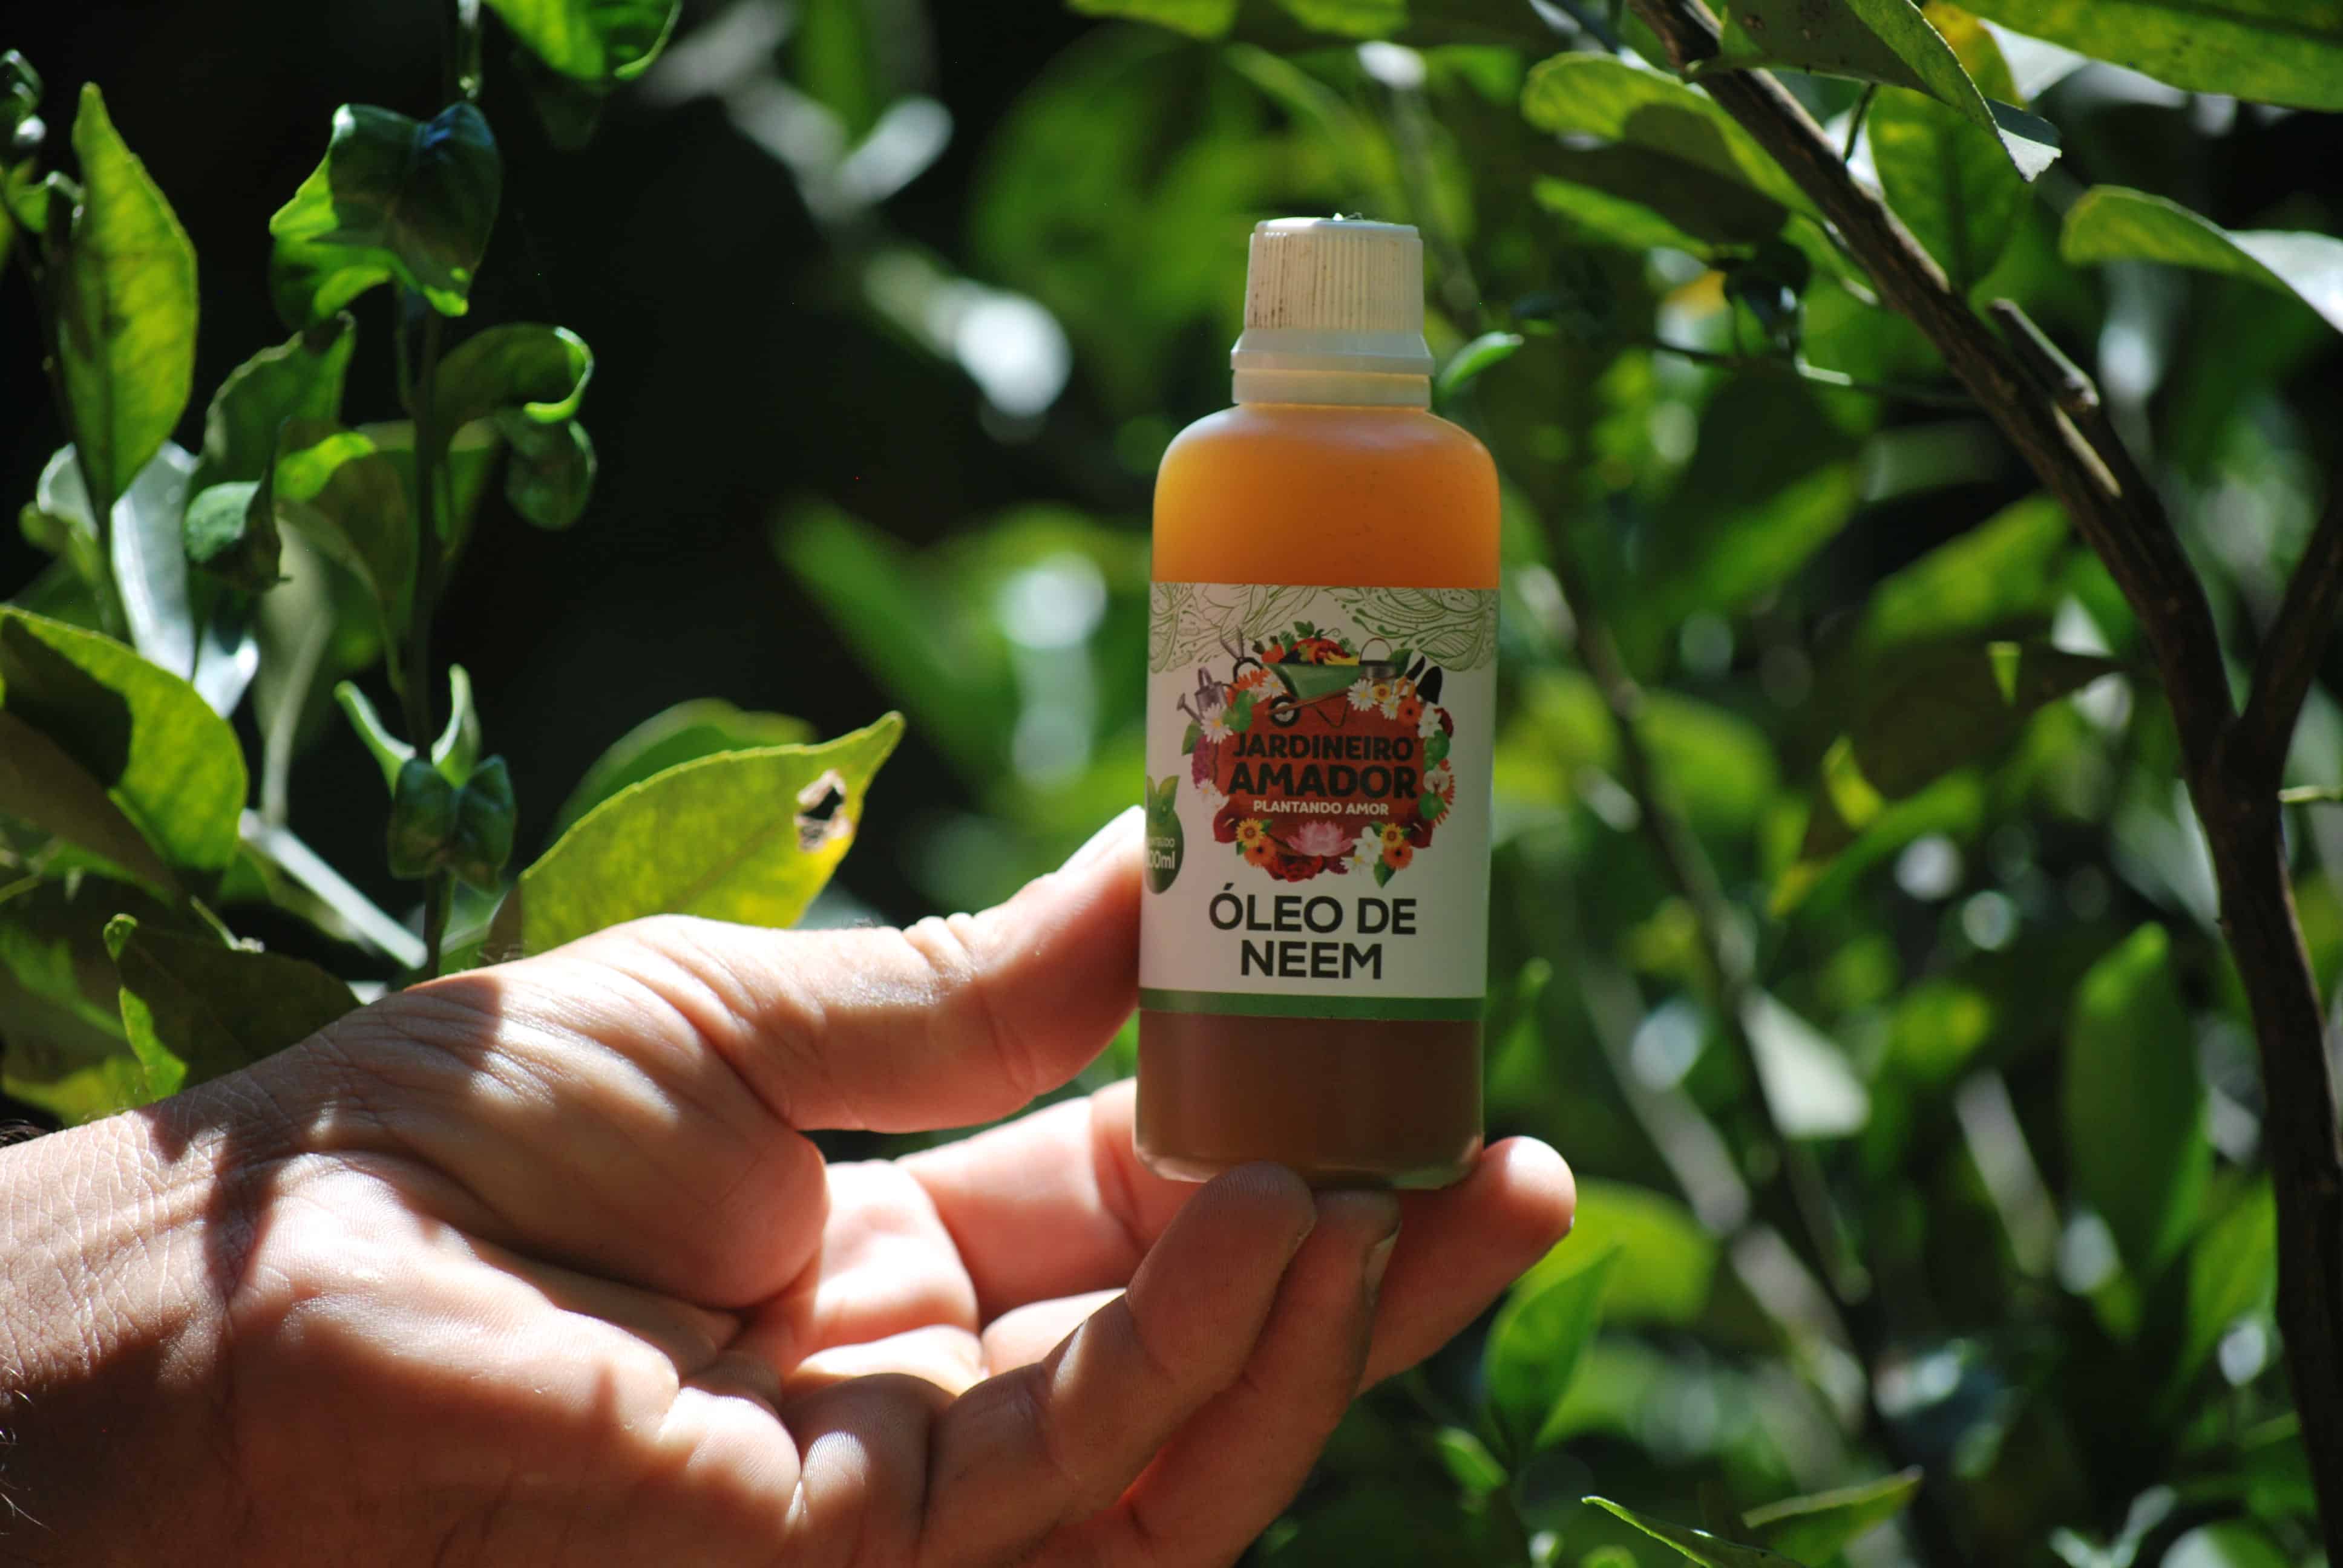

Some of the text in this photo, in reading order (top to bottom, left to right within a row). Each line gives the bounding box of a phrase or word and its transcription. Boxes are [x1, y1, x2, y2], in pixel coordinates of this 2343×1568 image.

[1233, 734, 1413, 761] JARDINEIRO
[1228, 763, 1417, 799] AMADOR
[1253, 800, 1389, 815] PLANTANDO AMOR
[1147, 851, 1175, 869] 00ml
[1209, 882, 1417, 935] ÓLEO DE
[1240, 940, 1382, 979] NEEM
